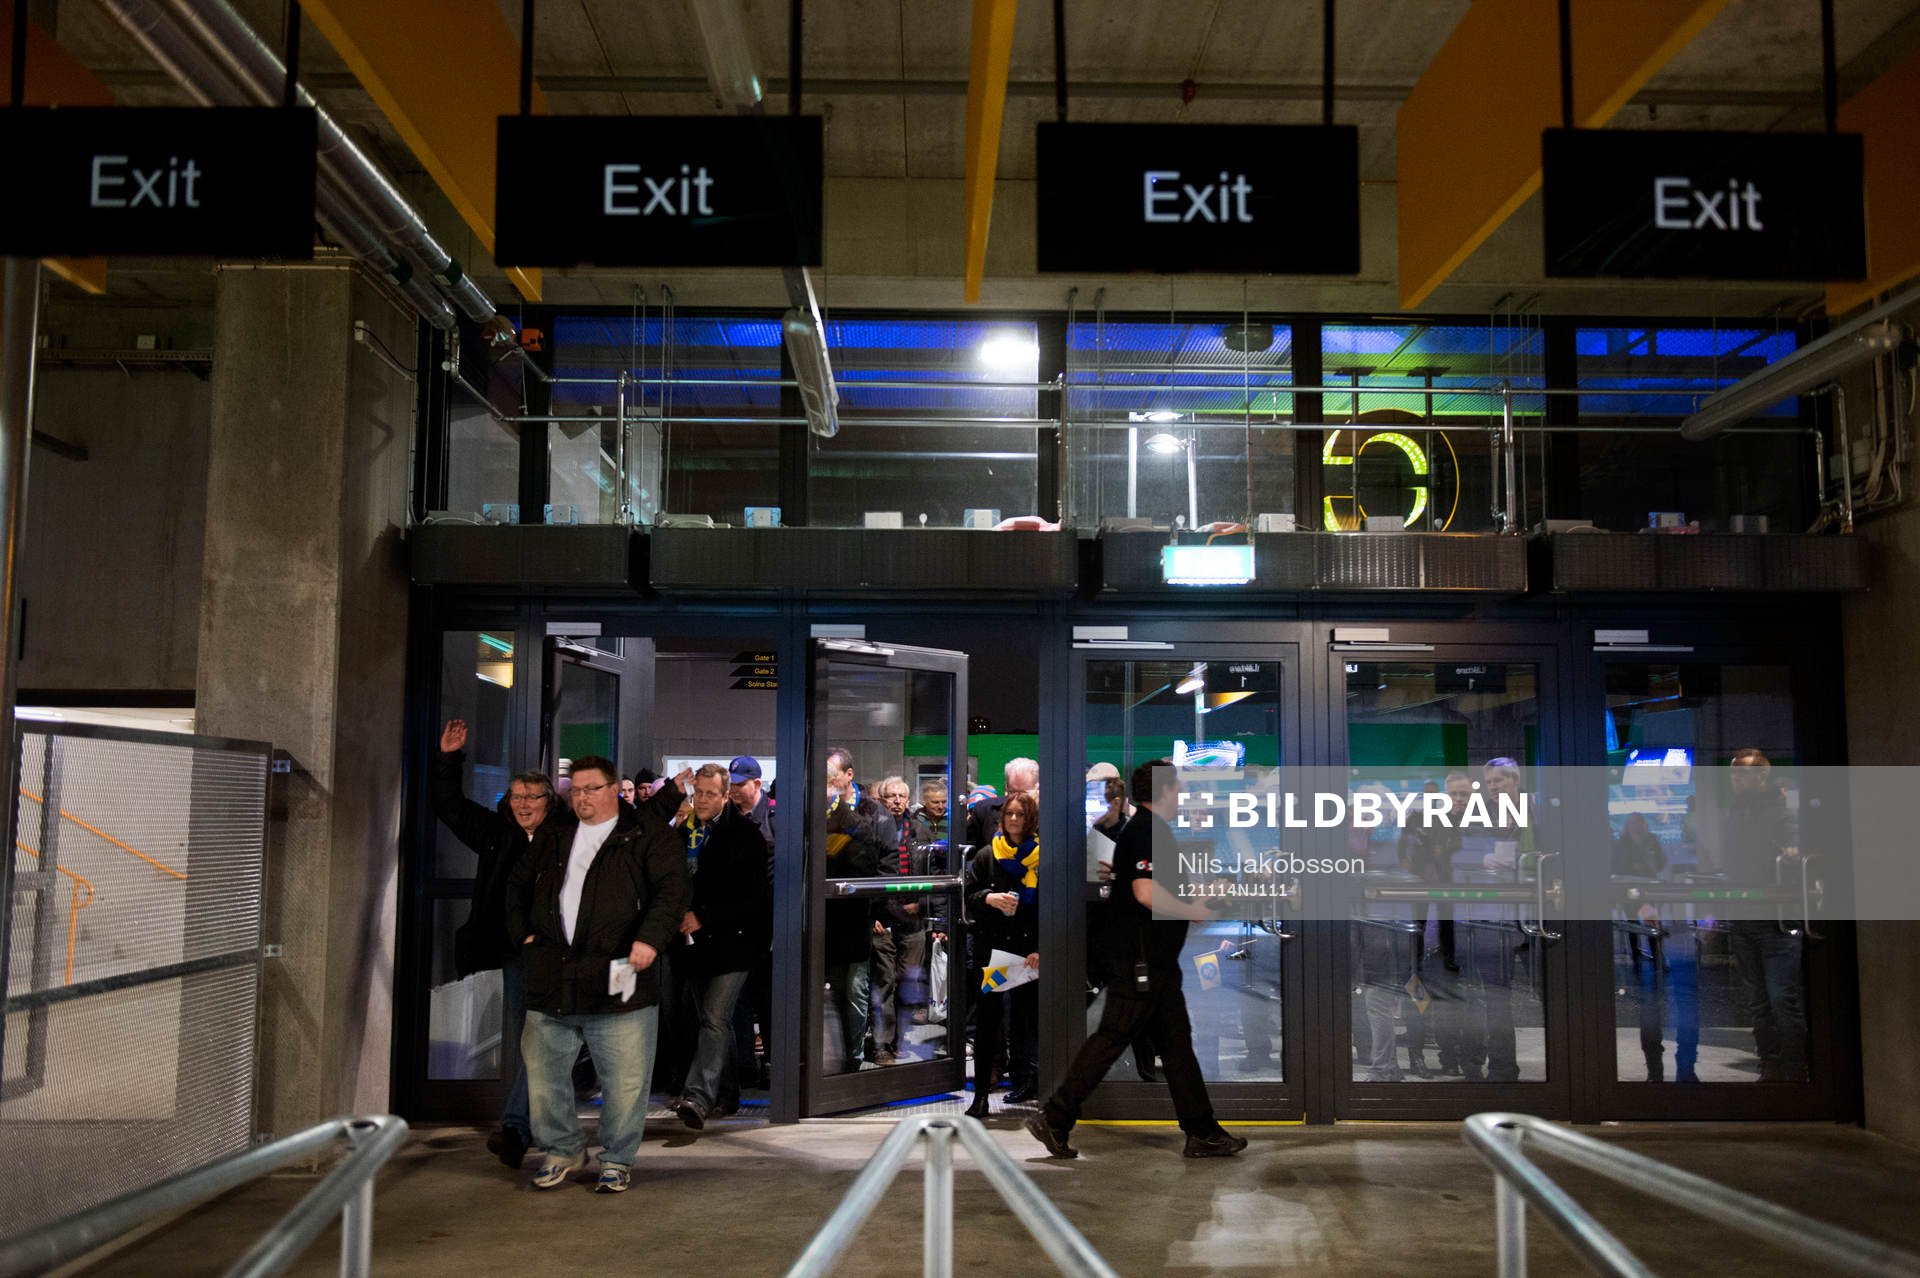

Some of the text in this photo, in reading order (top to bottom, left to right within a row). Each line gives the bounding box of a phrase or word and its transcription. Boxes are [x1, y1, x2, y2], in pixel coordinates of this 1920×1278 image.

[91, 156, 202, 208] Exit
[603, 163, 714, 215] Exit
[1143, 170, 1254, 223] Exit
[1654, 177, 1763, 230] Exit
